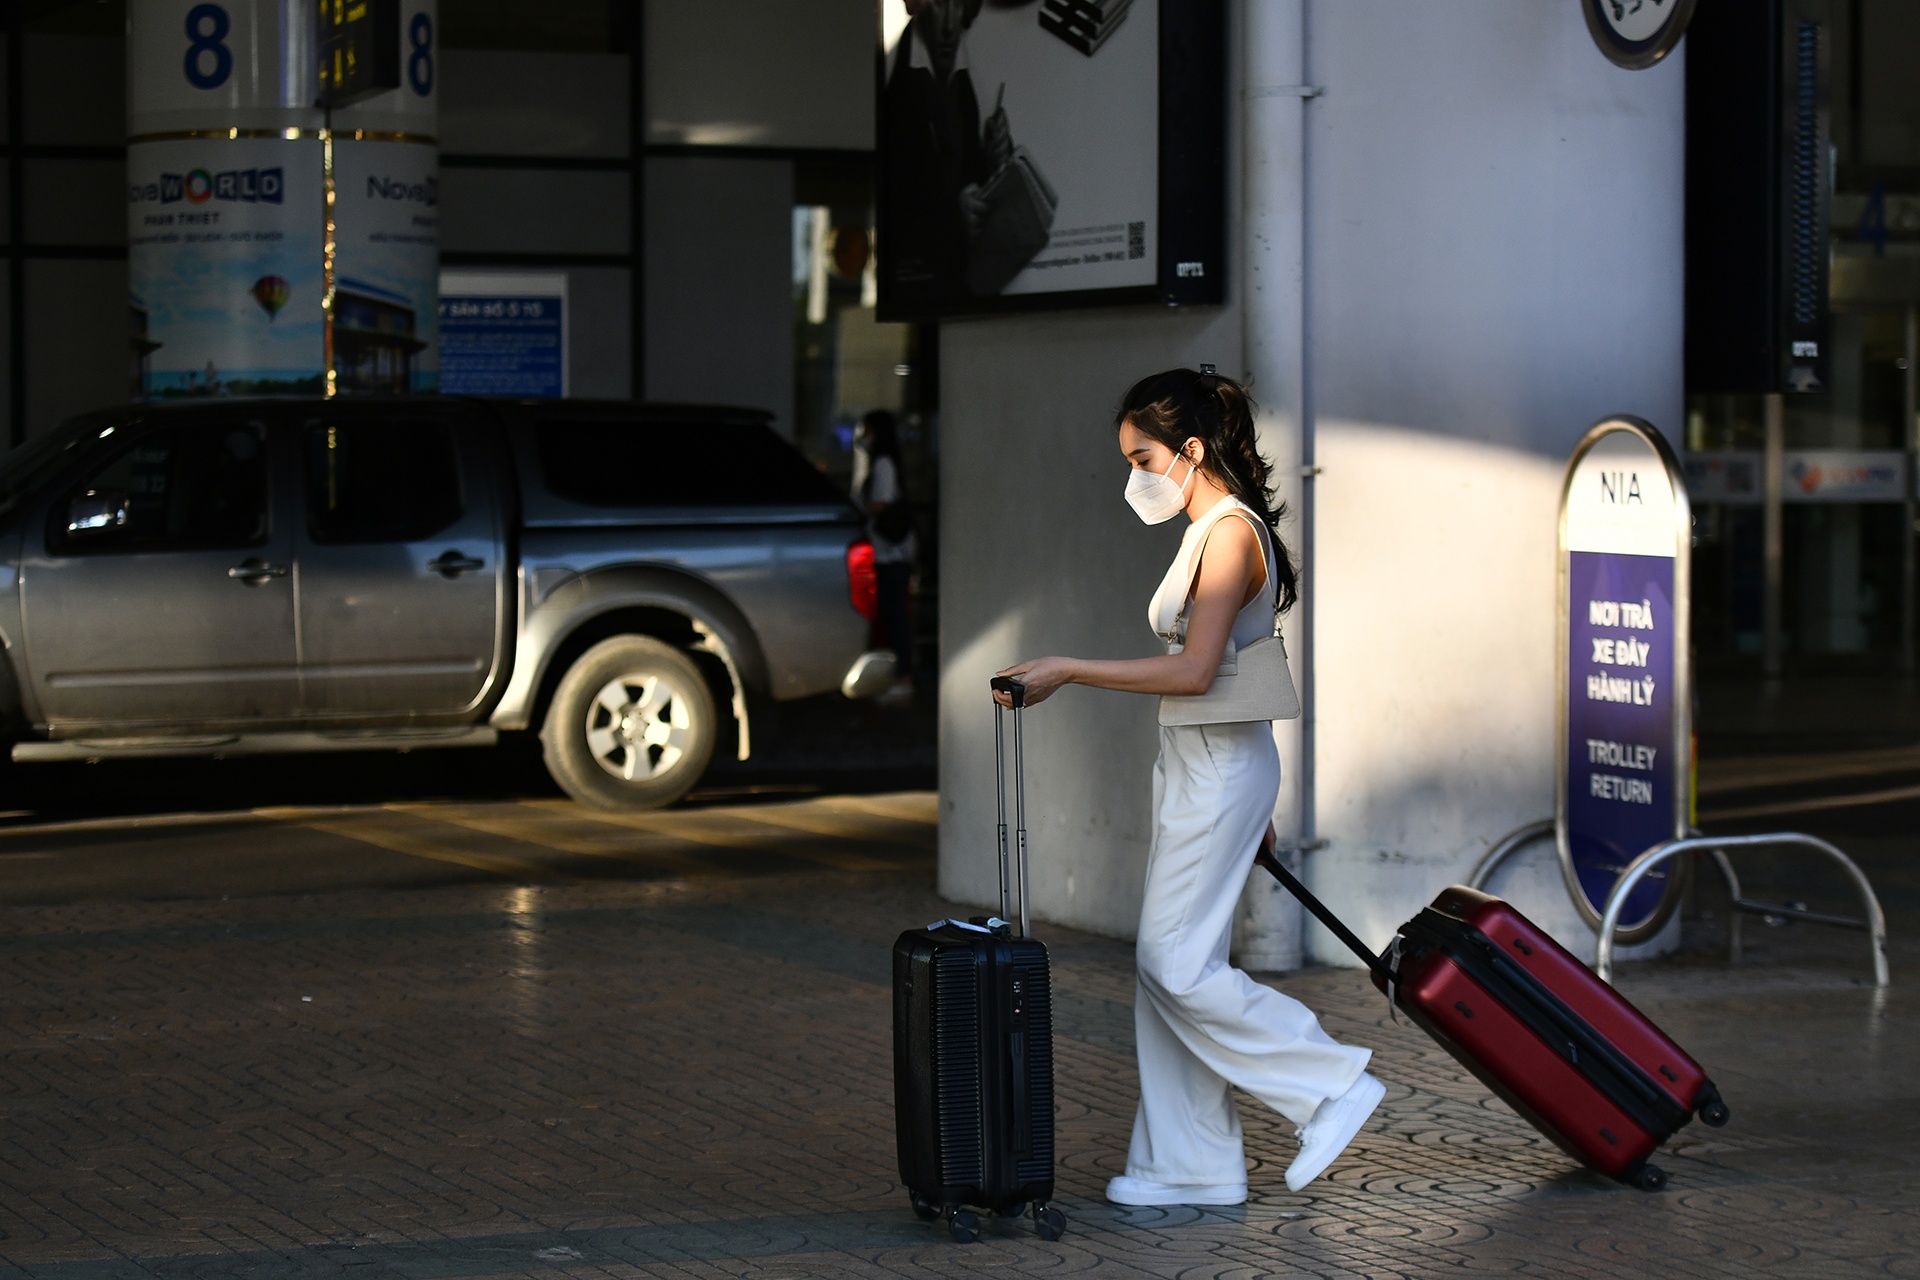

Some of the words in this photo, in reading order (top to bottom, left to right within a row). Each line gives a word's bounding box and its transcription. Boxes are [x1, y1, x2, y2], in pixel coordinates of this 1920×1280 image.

[184, 3, 232, 90] 8
[410, 12, 432, 97] 8
[129, 168, 283, 204] ovaWORLD
[366, 175, 438, 207] Nova
[1858, 178, 1890, 257] 4
[1601, 471, 1643, 505] NIA
[1592, 637, 1615, 664] XE
[1586, 739, 1657, 771] TROLLEY
[1590, 773, 1653, 805] RETURN
